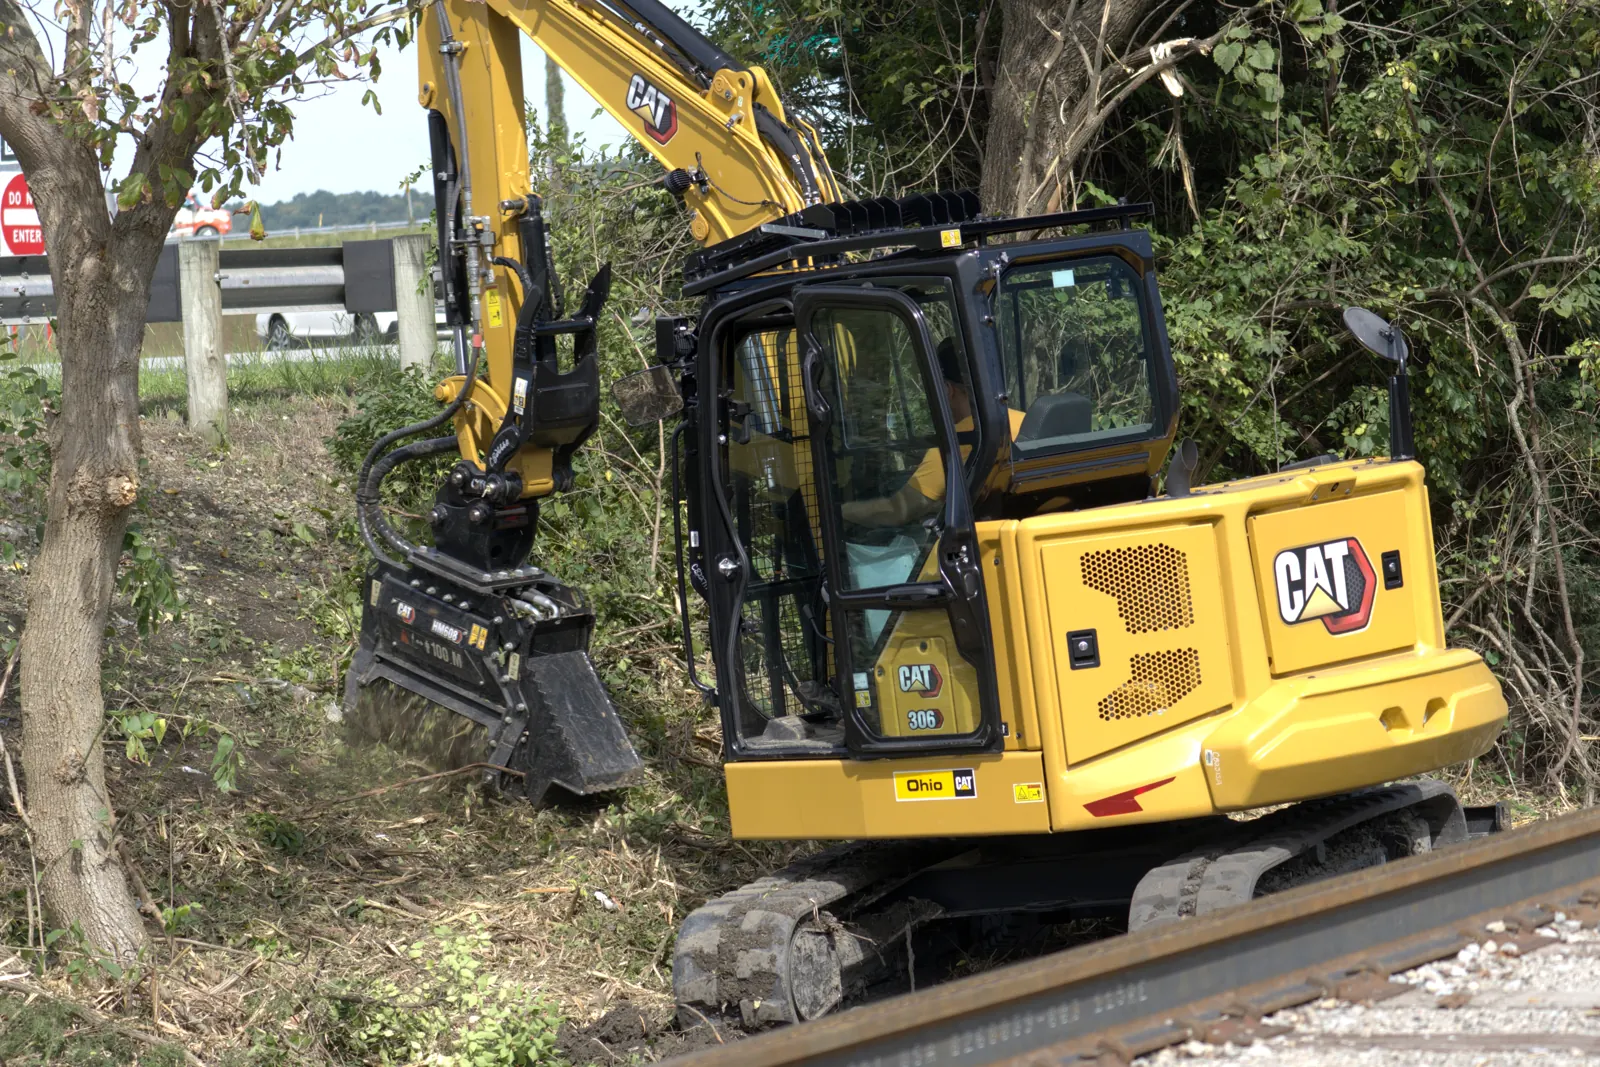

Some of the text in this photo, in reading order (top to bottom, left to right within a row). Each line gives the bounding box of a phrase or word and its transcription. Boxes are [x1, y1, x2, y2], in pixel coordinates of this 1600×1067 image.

[627, 74, 671, 129] CAT
[9, 191, 22, 205] DO
[13, 229, 42, 243] ENTER
[1275, 540, 1349, 622] CAT
[432, 619, 460, 642] HM608
[899, 665, 932, 692] CAT
[908, 710, 936, 730] 306
[906, 776, 972, 792] Ohio CAT
